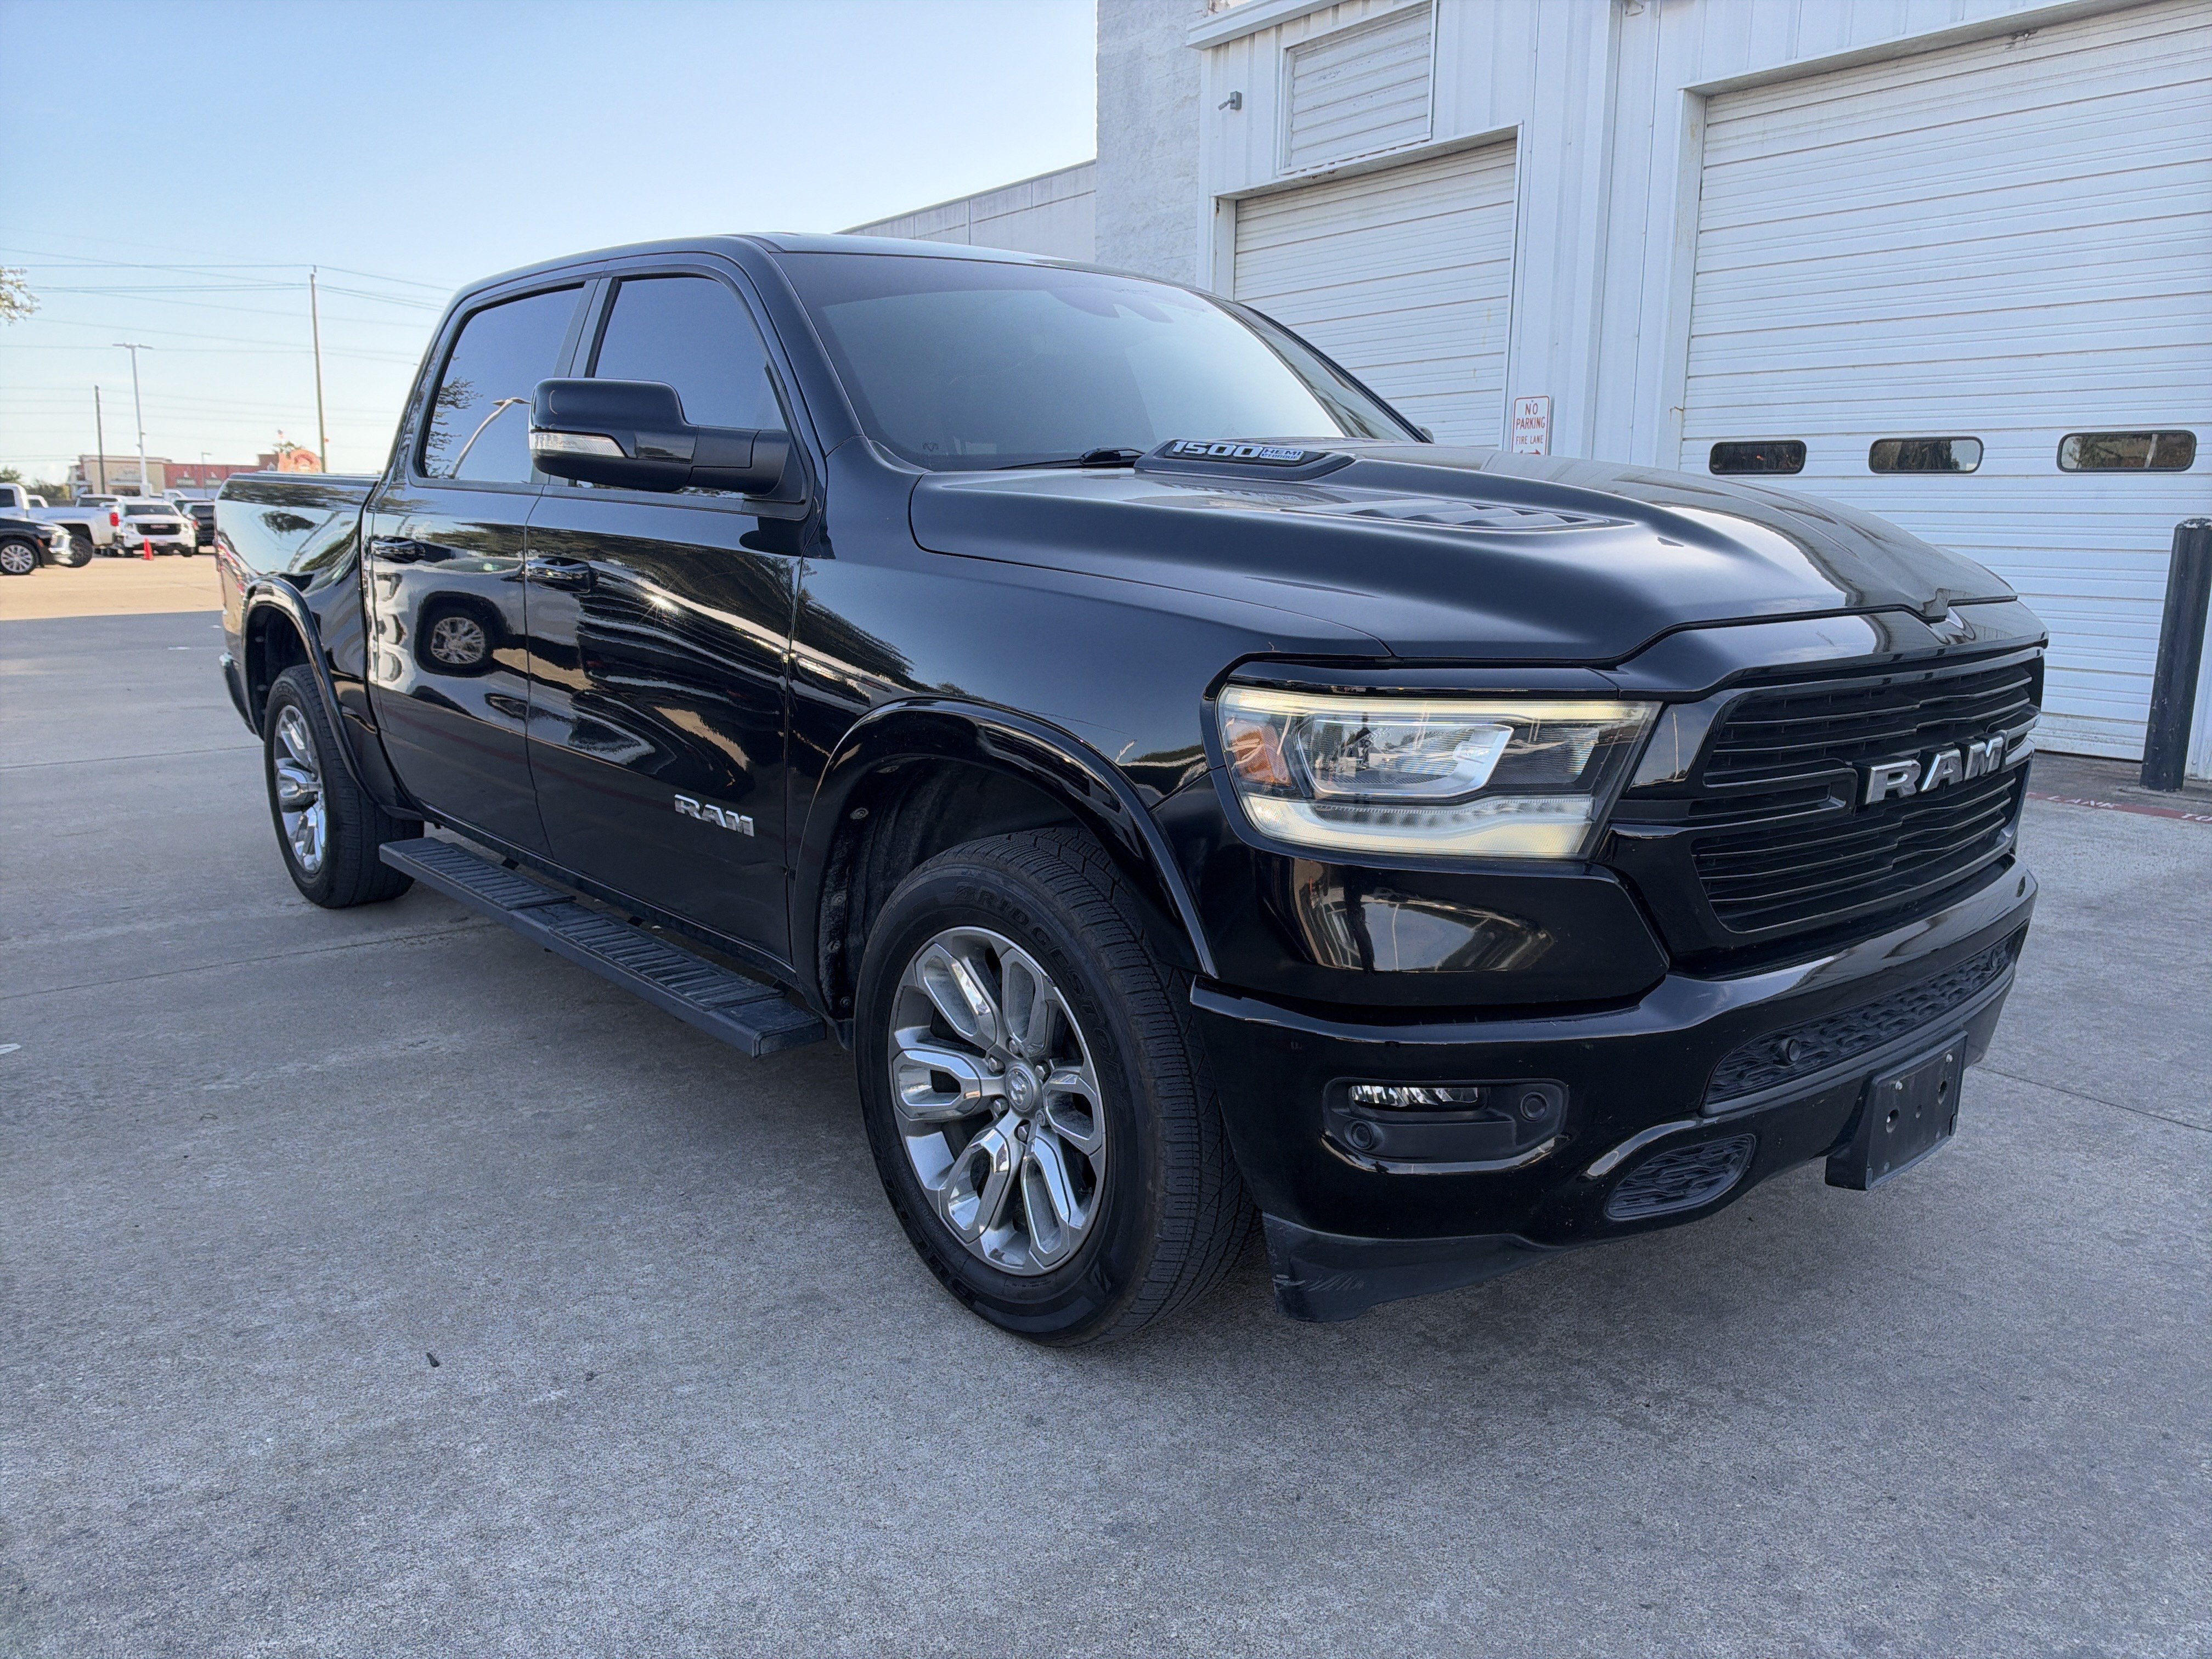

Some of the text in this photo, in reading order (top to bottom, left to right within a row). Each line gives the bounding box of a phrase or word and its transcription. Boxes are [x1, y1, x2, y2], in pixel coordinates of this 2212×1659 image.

[1525, 403, 1538, 415] NO
[1516, 416, 1545, 430] PARKING
[1515, 435, 1543, 445] FIRE LANE
[1172, 441, 1262, 458] 1500
[1865, 736, 2003, 804] RAM
[674, 794, 755, 837] RAM
